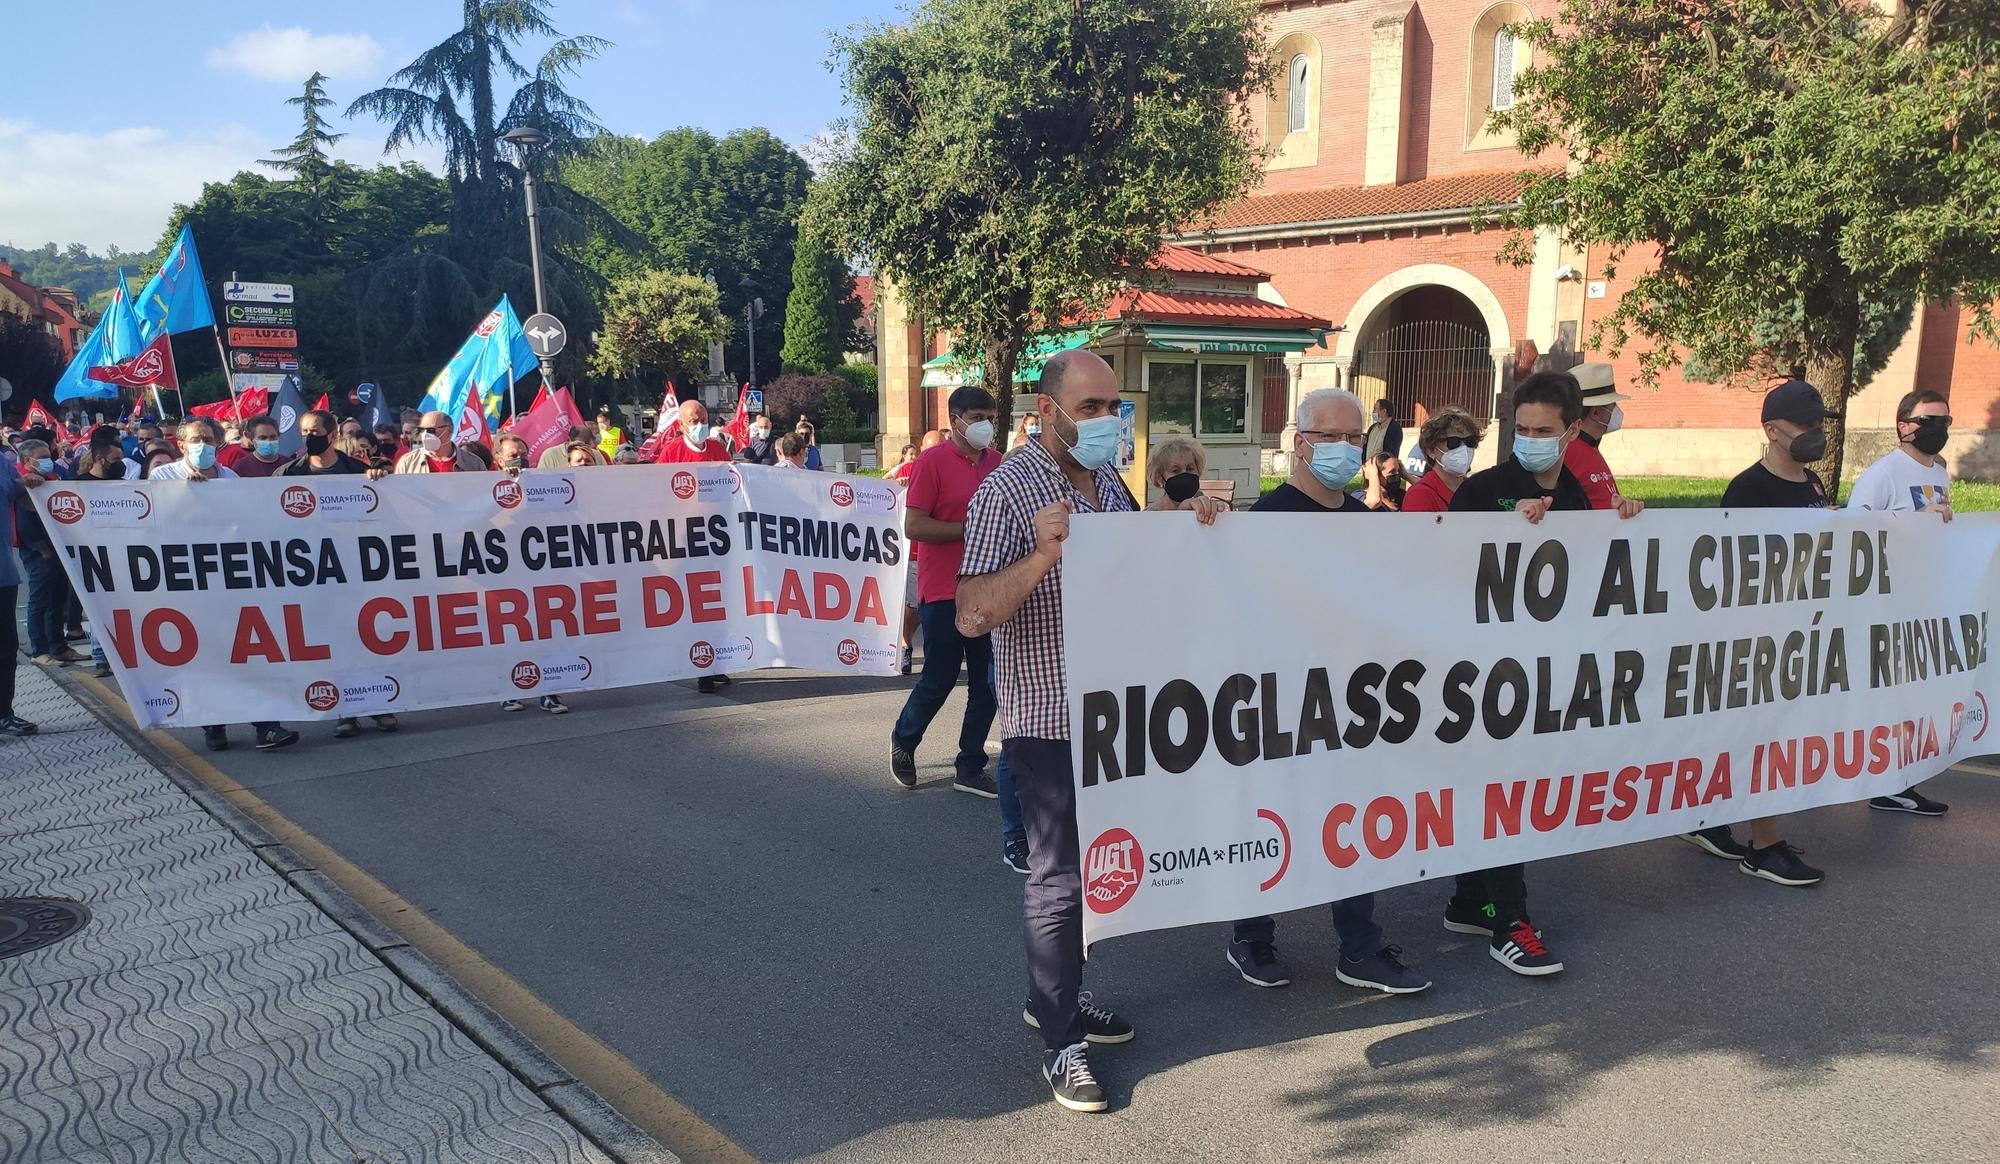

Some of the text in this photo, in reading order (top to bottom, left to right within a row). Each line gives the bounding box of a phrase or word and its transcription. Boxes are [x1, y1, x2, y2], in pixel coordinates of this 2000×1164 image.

[244, 306, 273, 314] SECOND
[255, 330, 294, 338] LUZES
[674, 475, 693, 488] UGT
[284, 490, 311, 505] UGT
[496, 484, 518, 498] UGT
[526, 486, 570, 496] SOMA FITAG
[833, 484, 851, 498] UGT
[52, 496, 80, 510] UGT
[89, 499, 144, 508] SOMA FITAG
[319, 494, 373, 504] SOMA FITAG
[66, 511, 901, 593] N DEFENSA DE LAS CENTRALES TERMICAS
[1475, 529, 1891, 624] NO AL CIERRE DE
[103, 565, 889, 669] NO AL CIERRE DE LADA
[693, 645, 712, 658] UGT
[840, 643, 857, 654] UGT
[514, 665, 537, 680] UGT
[542, 663, 587, 675] SOMA FITAG
[309, 685, 335, 700] UGT
[343, 684, 394, 696] SOMA FITAG
[150, 697, 174, 707] FITAG
[1082, 659, 1427, 788] RIOGLASS
[1434, 649, 1645, 744] SOLAR
[1663, 610, 1850, 719] ENERGÍA
[1322, 715, 1940, 869] CON NUESTRA INDUSTRIA
[1088, 839, 1135, 878] UGT
[1149, 837, 1279, 874] SOMA FITAG
[1151, 876, 1185, 888] Asturias
